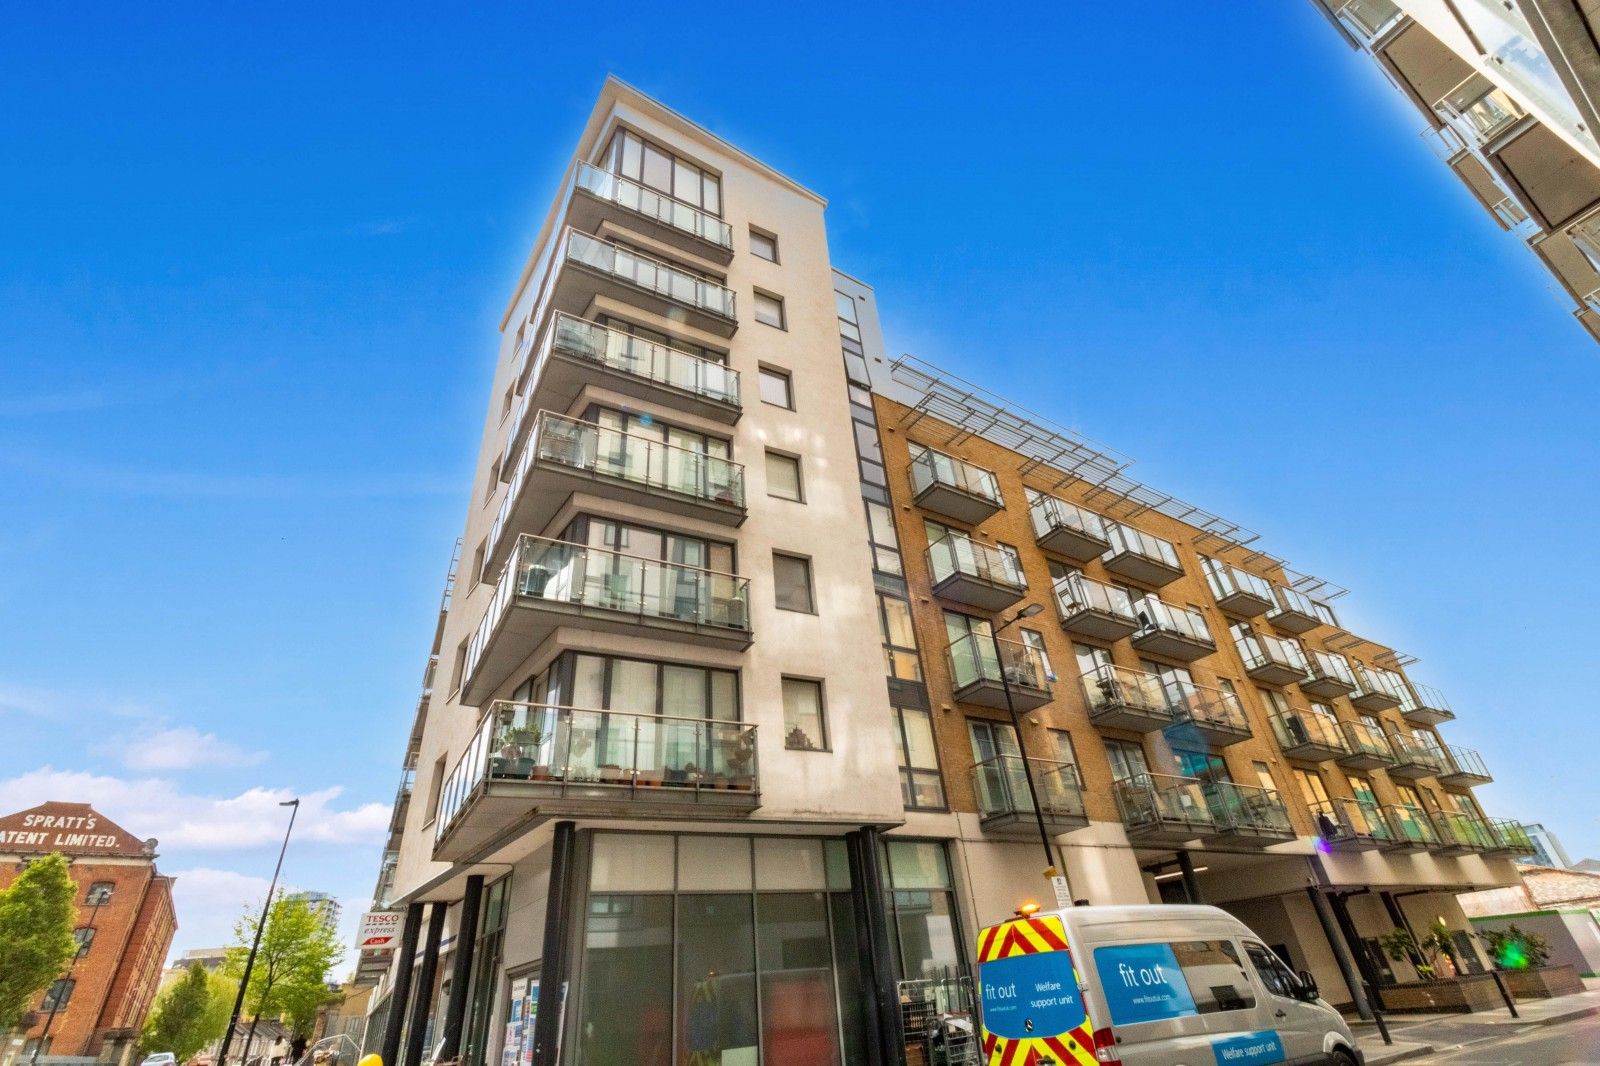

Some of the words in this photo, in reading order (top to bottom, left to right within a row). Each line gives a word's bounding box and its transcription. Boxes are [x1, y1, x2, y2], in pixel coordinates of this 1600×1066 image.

[23, 813, 97, 830] SPRATT'S
[54, 833, 120, 848] LIMITED.
[367, 914, 399, 923] TESCO
[364, 927, 396, 935] express
[1118, 962, 1139, 987] fit
[1140, 963, 1168, 986] out
[985, 983, 996, 1000] fit
[998, 982, 1017, 999] out
[1034, 981, 1062, 992] Welfare
[1030, 997, 1058, 1009] support
[1058, 994, 1074, 1005] unit
[1221, 1047, 1244, 1060] Welfare
[1244, 1044, 1266, 1057] support
[1265, 1041, 1277, 1052] unit
